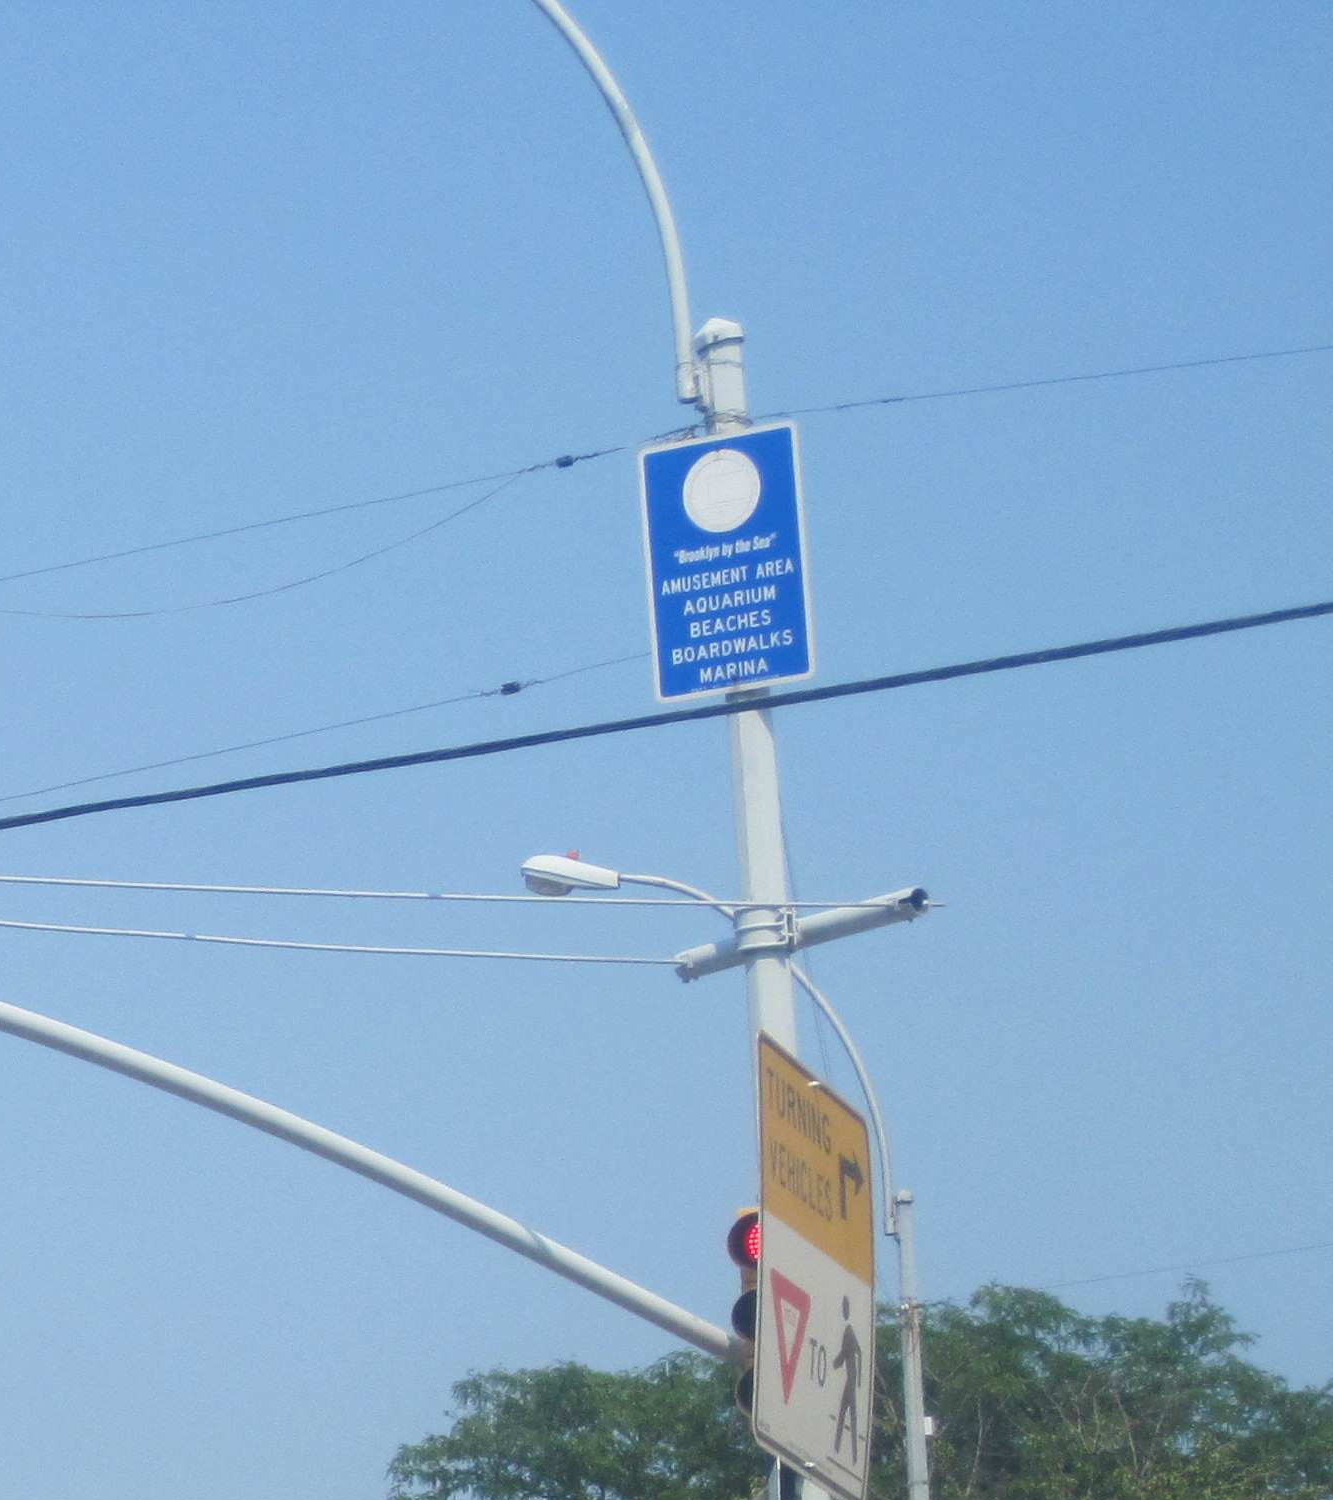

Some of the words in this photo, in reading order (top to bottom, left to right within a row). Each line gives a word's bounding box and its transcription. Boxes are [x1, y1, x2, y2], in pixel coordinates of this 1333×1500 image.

[661, 565, 748, 596] AMUSEMENT
[756, 558, 794, 580] AREA
[683, 585, 777, 616] AQUARIUM
[689, 609, 772, 639] BEACHES
[672, 629, 794, 665] BOARDWALKS
[699, 658, 770, 684] MARINA
[766, 1067, 832, 1156] TURNING
[770, 1136, 833, 1222] VEHICLES
[809, 1336, 828, 1388] TO
